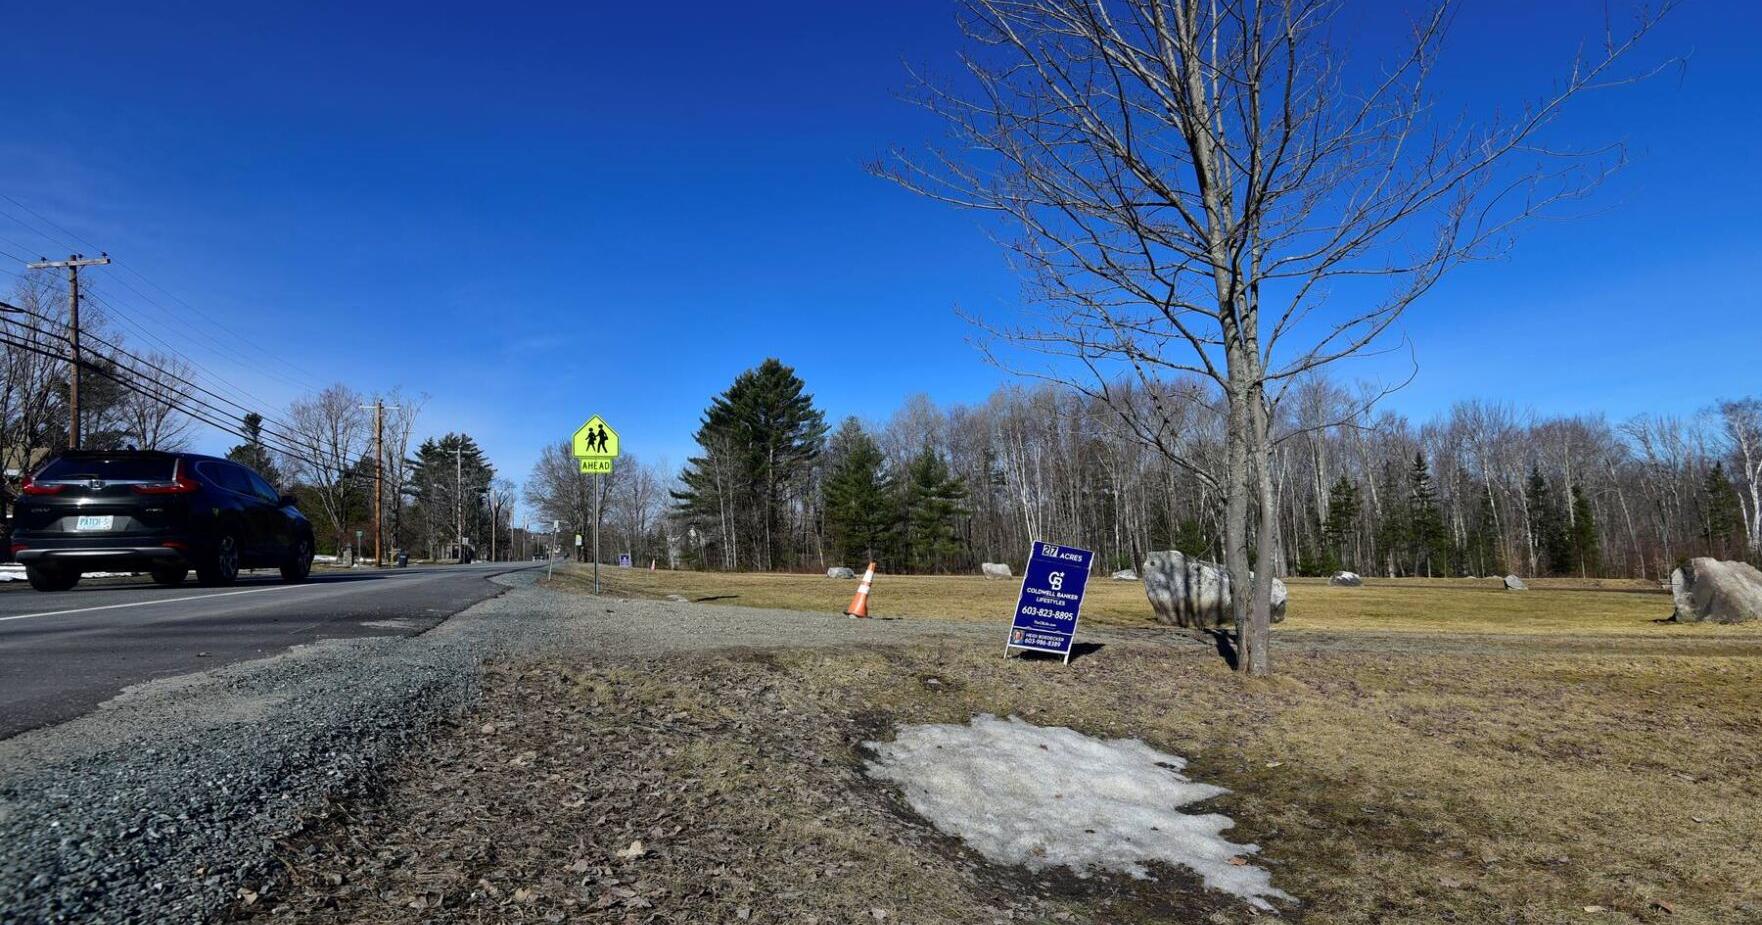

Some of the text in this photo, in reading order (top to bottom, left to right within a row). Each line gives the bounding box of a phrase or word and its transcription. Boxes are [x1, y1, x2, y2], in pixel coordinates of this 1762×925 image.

[582, 461, 610, 470] AHEAD
[1042, 545, 1082, 562] 27 ACRES
[1027, 587, 1078, 600] COLDWELL BANKER
[1036, 597, 1066, 606] LIFESTYLES
[1022, 606, 1073, 621] 603-823-8895
